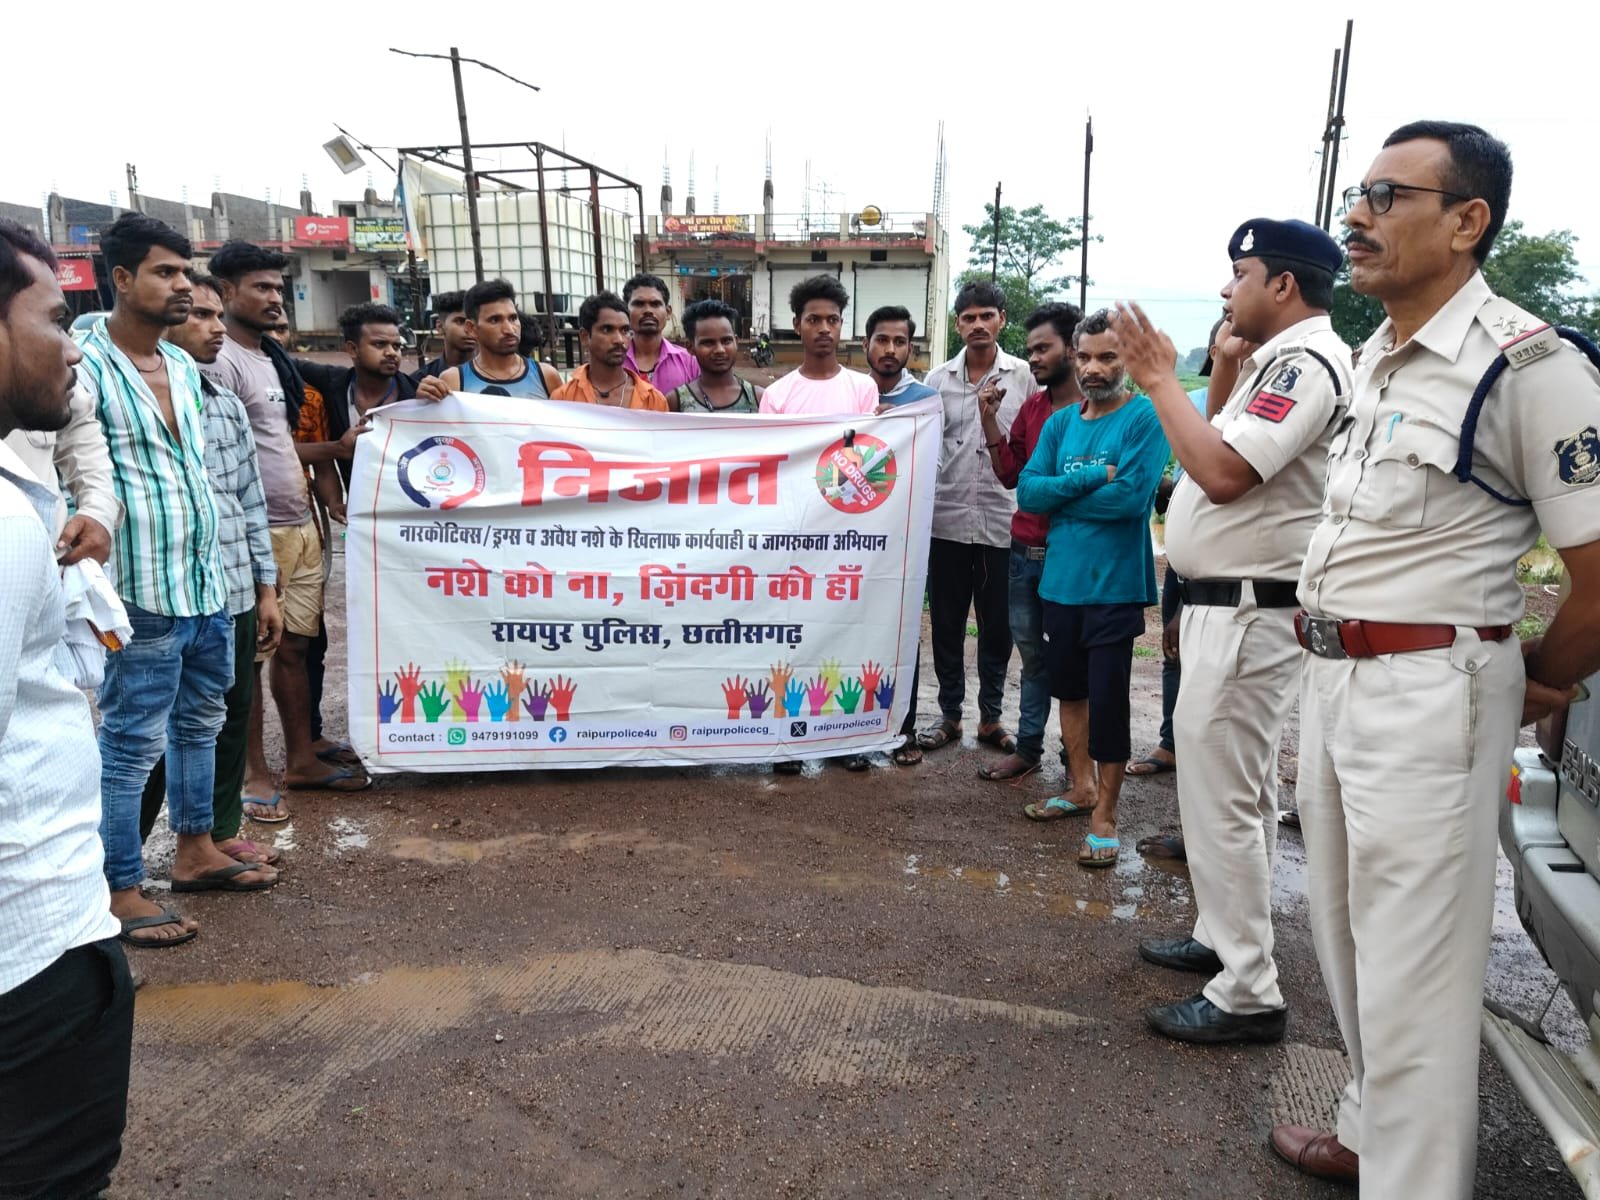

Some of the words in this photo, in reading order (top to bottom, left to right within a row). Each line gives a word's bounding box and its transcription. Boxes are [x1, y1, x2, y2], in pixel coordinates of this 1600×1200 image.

[517, 441, 789, 506] निजात
[830, 450, 848, 466] NO
[846, 465, 877, 501] DRUGS
[526, 529, 536, 546] व
[541, 524, 576, 547] अवैध
[581, 525, 605, 548] नशे
[609, 526, 624, 548] के
[628, 527, 682, 549] खिलाफ
[685, 528, 744, 550] कार्यवाही
[748, 534, 759, 550] व
[833, 529, 888, 551] अभियान
[425, 558, 492, 597] नशे
[503, 561, 556, 598] को
[566, 571, 624, 607] ना,
[767, 566, 816, 600] को
[491, 621, 574, 651] रायपुर
[582, 618, 671, 651] पुलिस,
[682, 619, 803, 649] छत्तीसगढ़
[388, 732, 435, 744] Contact
[471, 730, 539, 741] 9479191099
[577, 729, 657, 741] raipurpolice4u
[692, 725, 775, 737] raipurpolicecg_
[813, 717, 882, 732] raipurpolicecg
